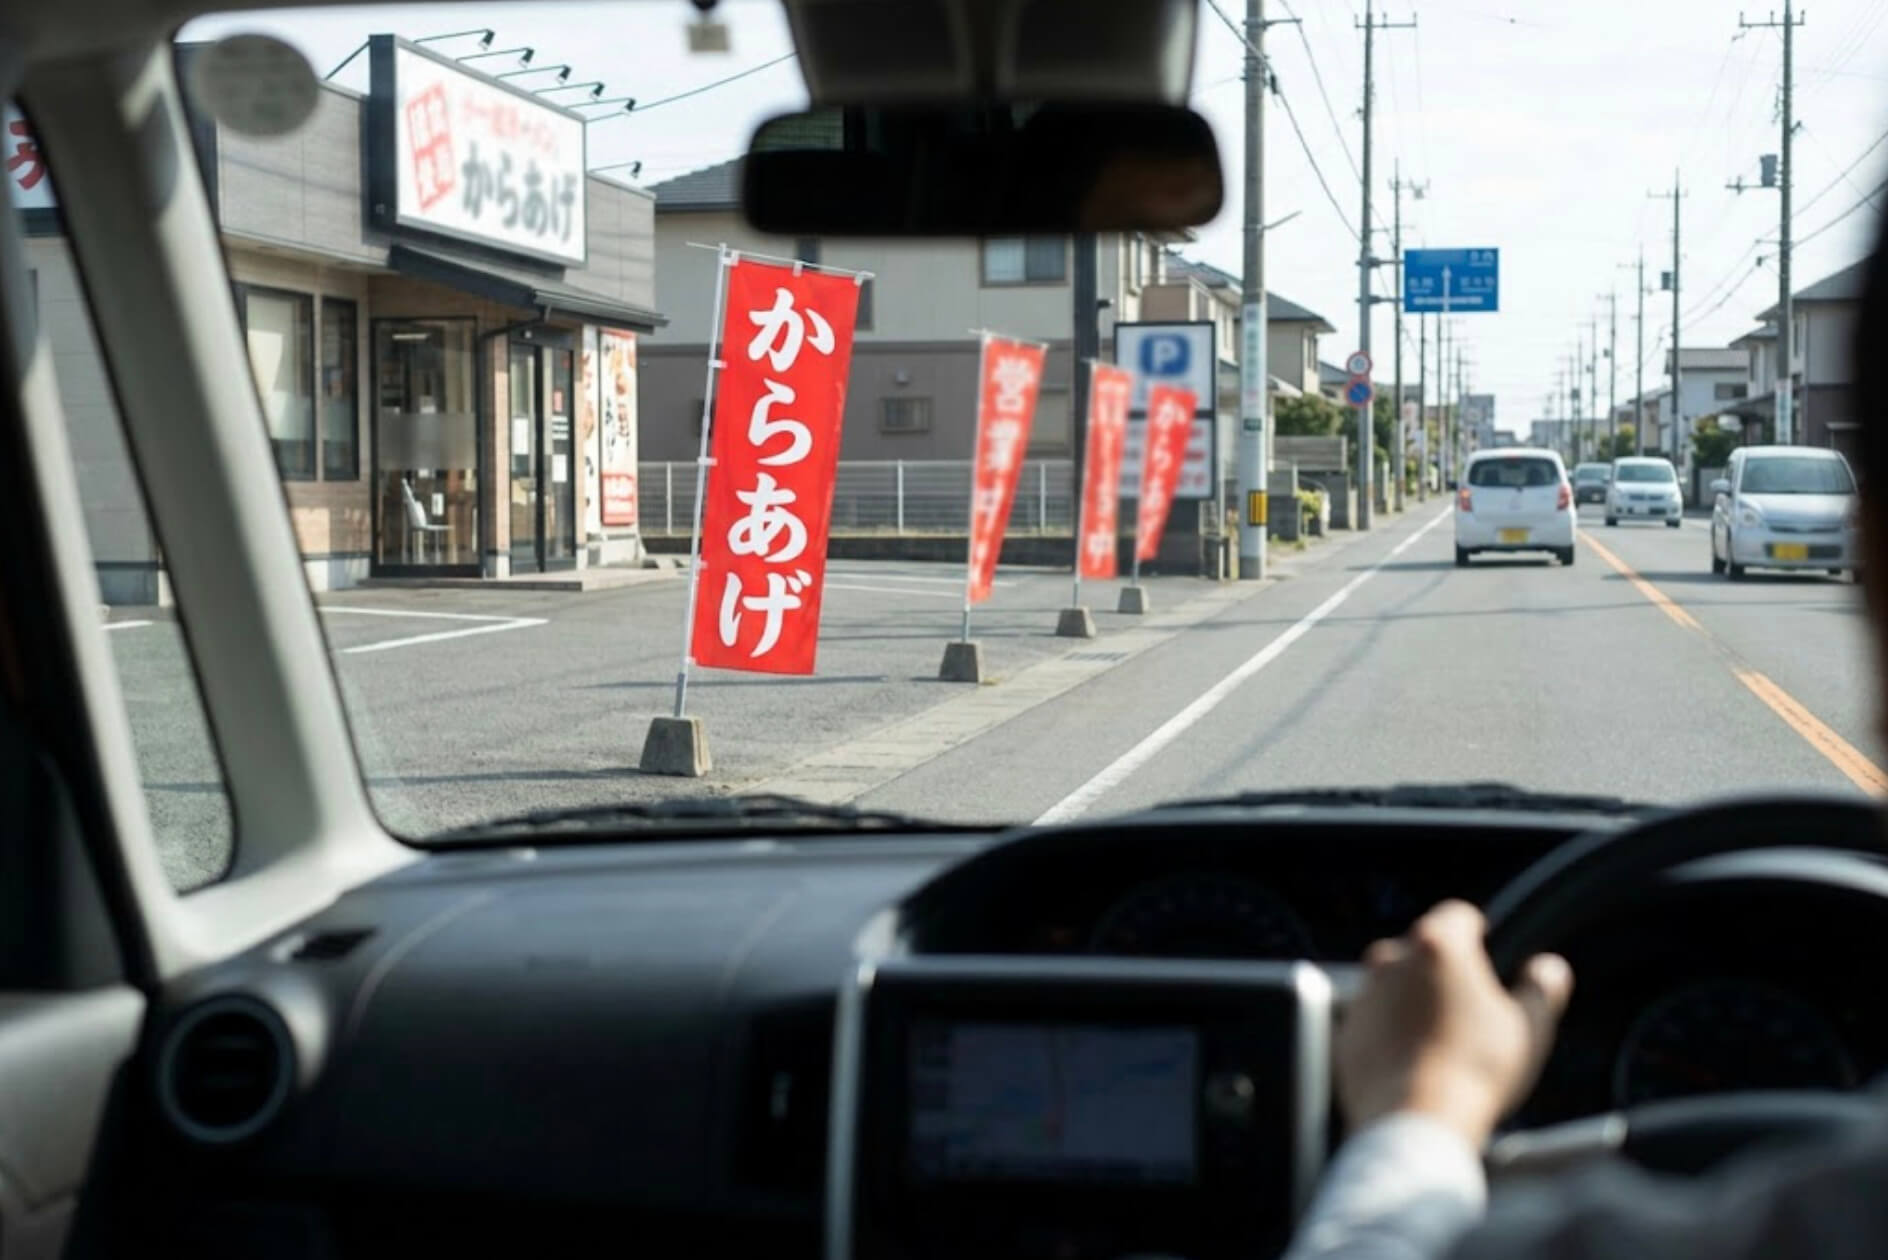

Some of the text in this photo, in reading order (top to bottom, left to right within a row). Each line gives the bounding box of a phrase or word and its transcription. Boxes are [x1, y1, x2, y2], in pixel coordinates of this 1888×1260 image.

[462, 139, 577, 243] からあげ
[1153, 337, 1179, 373] P
[718, 287, 835, 658] からあげ
